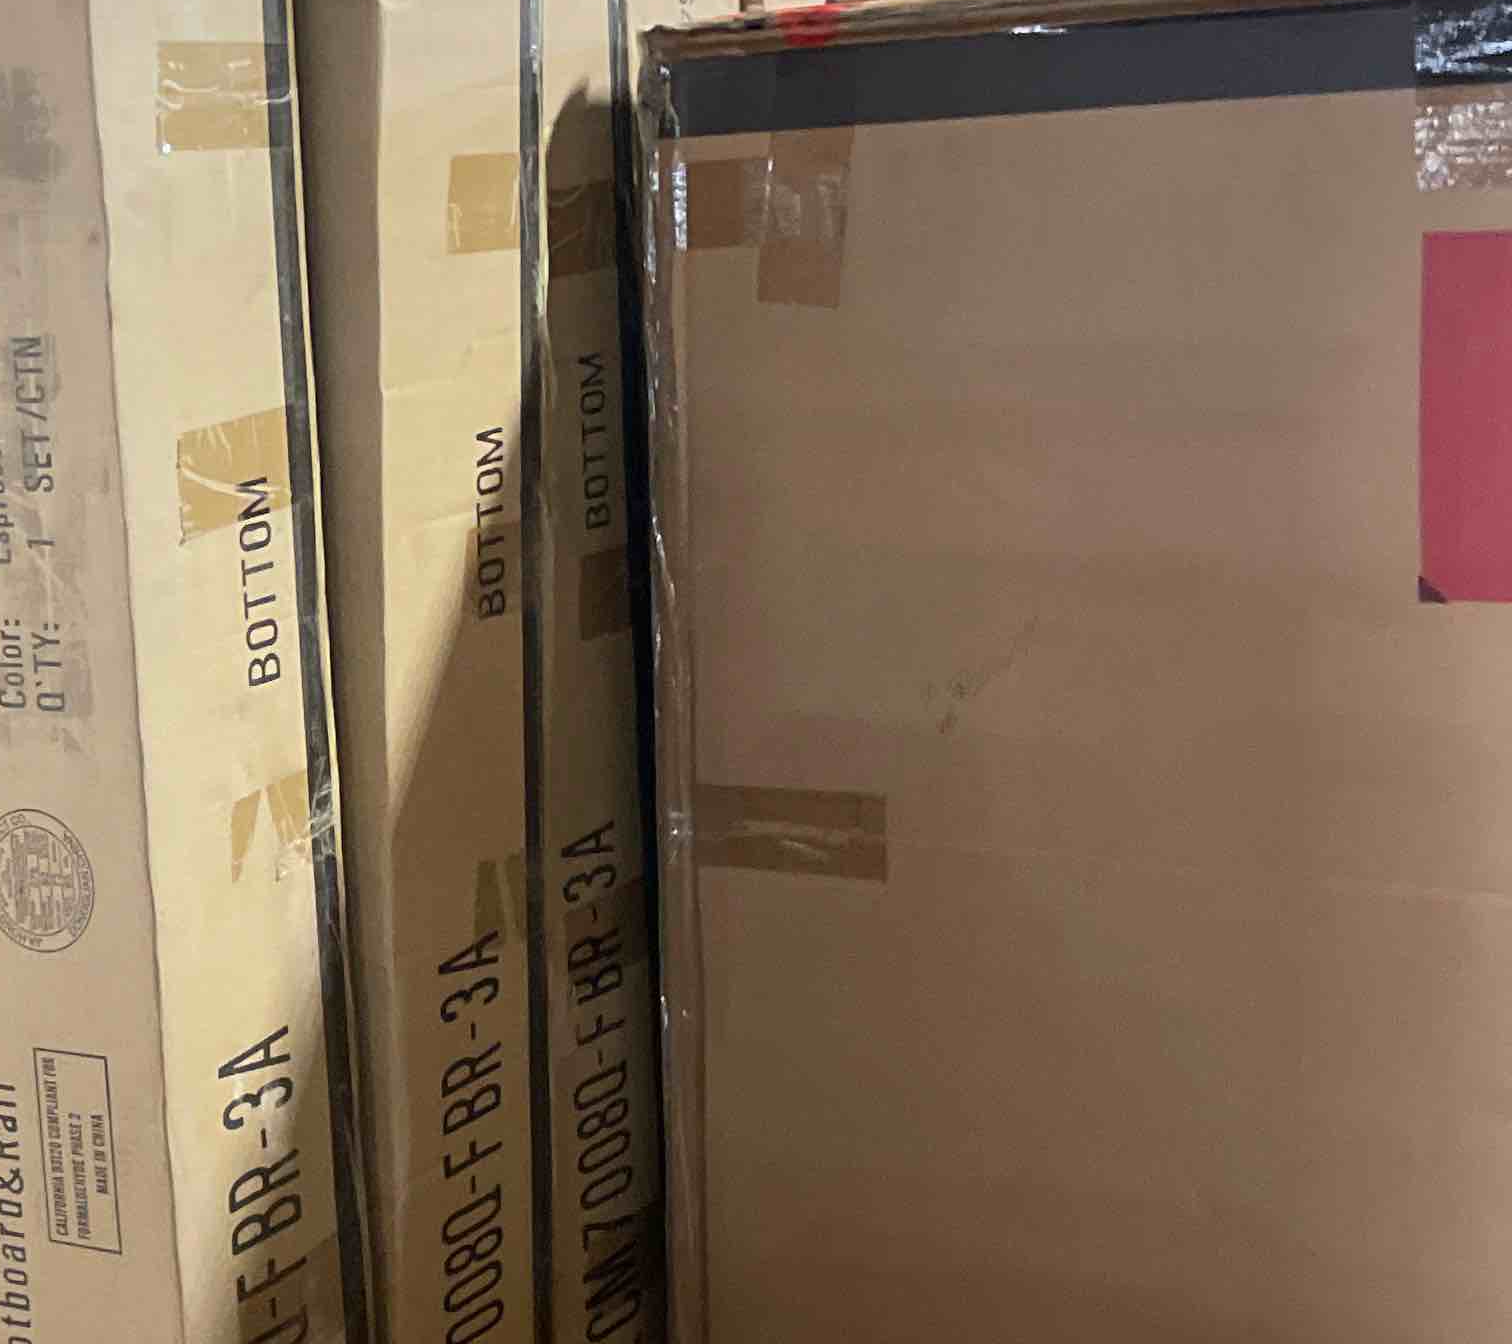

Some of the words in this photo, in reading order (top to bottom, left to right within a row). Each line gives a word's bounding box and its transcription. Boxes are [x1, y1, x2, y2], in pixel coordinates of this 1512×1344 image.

[576, 350, 610, 531] BOTTOM
[27, 537, 56, 549] 1
[475, 425, 506, 620] BOTTOM
[236, 474, 283, 688] BOTTOM
[89, 1113, 106, 1148] CHINA
[94, 1165, 110, 1196] MADE
